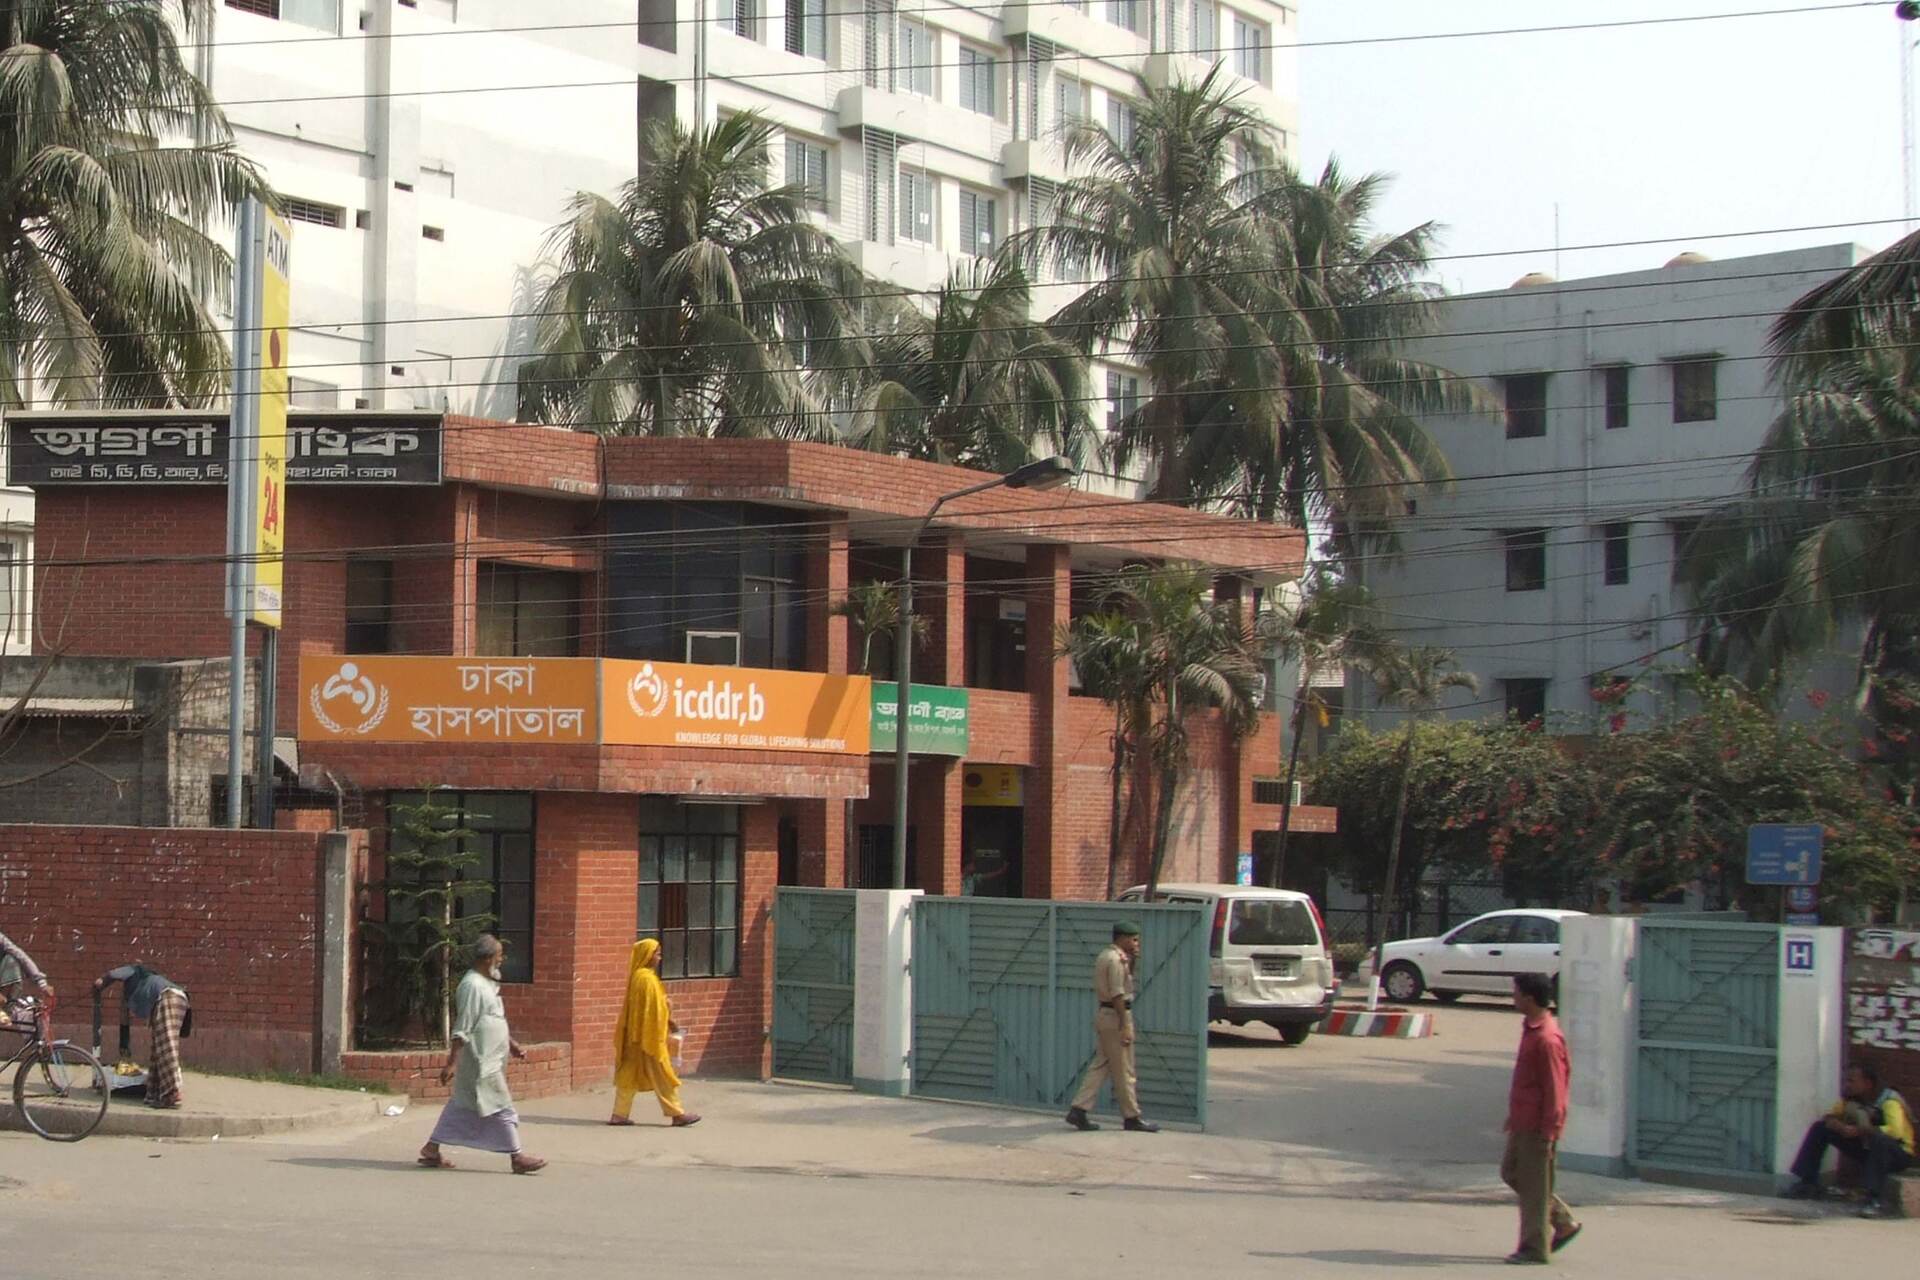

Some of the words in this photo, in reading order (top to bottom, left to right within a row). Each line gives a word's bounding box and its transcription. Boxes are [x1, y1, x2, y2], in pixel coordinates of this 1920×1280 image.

[266, 224, 288, 279] ATM
[262, 475, 279, 536] 24
[457, 663, 536, 696] ঢাকা
[673, 677, 765, 727] icddr,b
[407, 704, 585, 738] হাসপাতাল
[675, 731, 721, 745] KNOWLEDGE
[723, 733, 738, 745] FOR
[740, 734, 767, 747] GLOBAL
[1790, 944, 1810, 966] H
